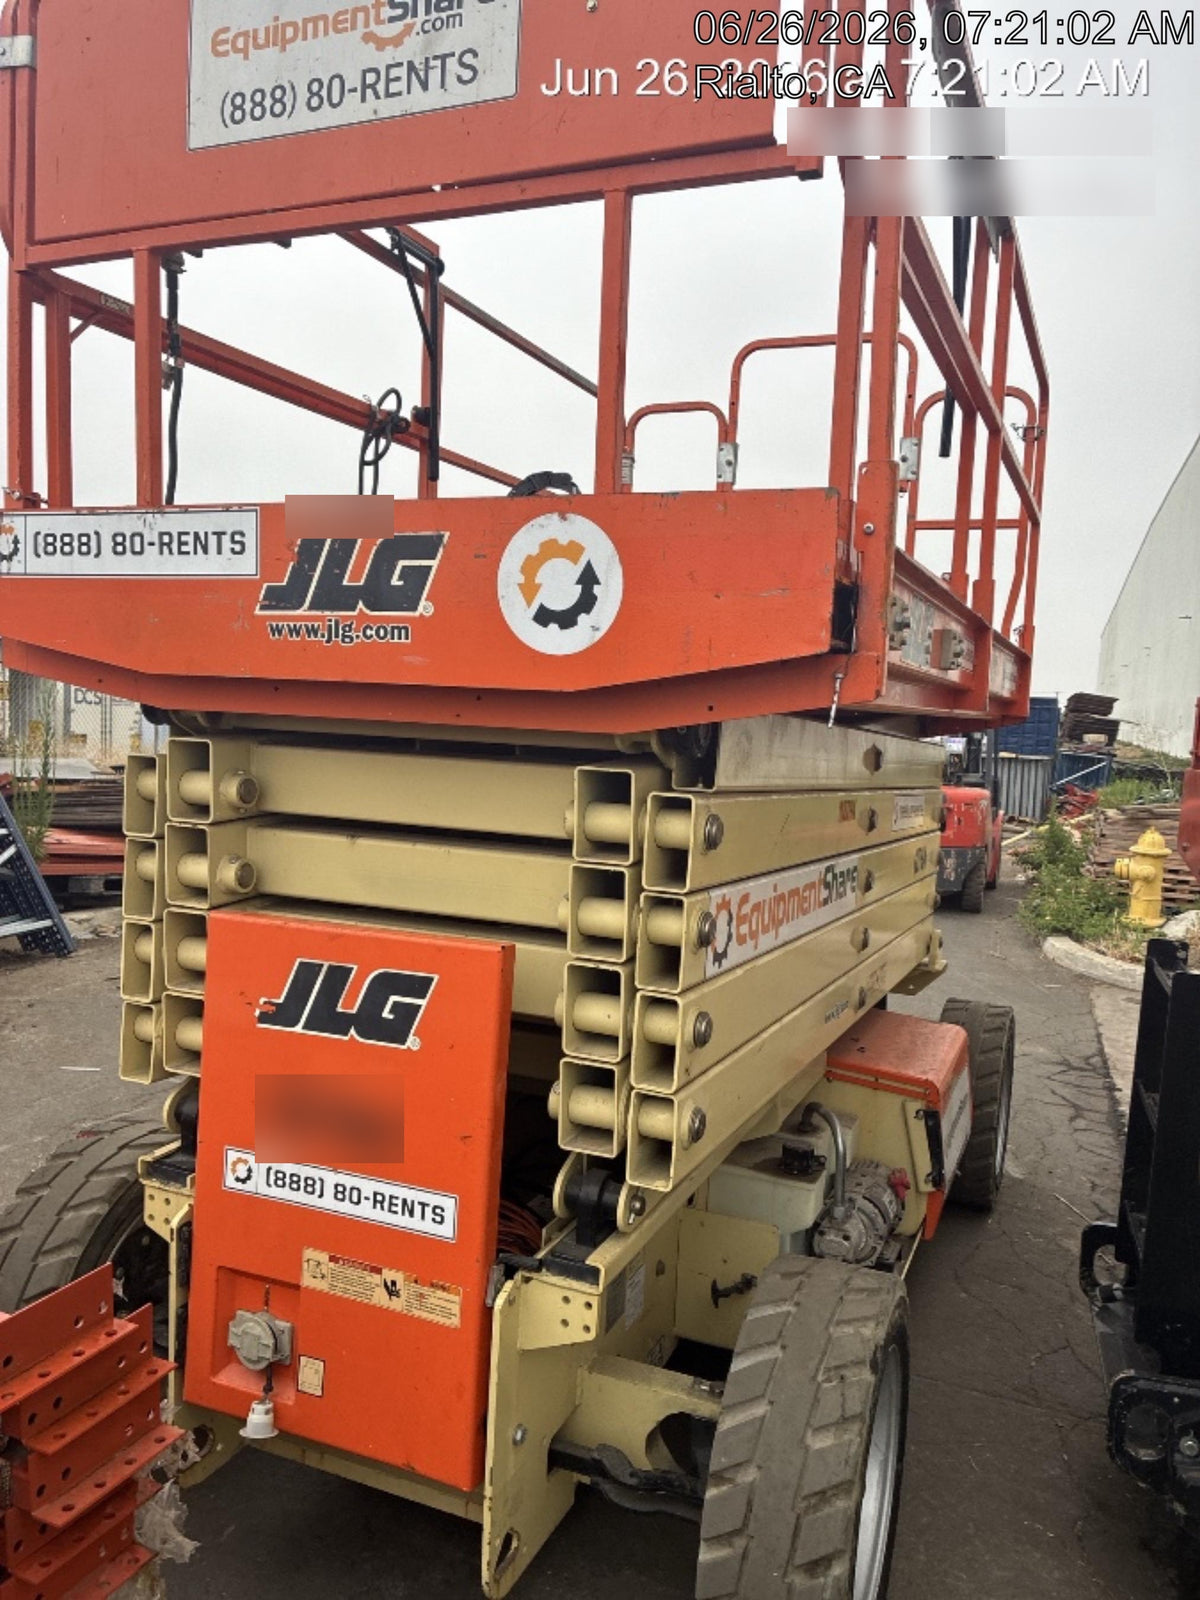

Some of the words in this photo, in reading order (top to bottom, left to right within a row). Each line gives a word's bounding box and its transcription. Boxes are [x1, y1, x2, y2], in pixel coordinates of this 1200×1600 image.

[210, 0, 496, 61] EquipmentSha
[415, 13, 464, 37] .com
[220, 78, 298, 128] (888)
[305, 47, 479, 113] 80-RENTS
[33, 530, 102, 559] (888)
[111, 529, 247, 557] 80-RENTS
[268, 618, 411, 646] www.jlg.com
[265, 1165, 325, 1199] (888)
[333, 1182, 446, 1226] 80-RENTS
